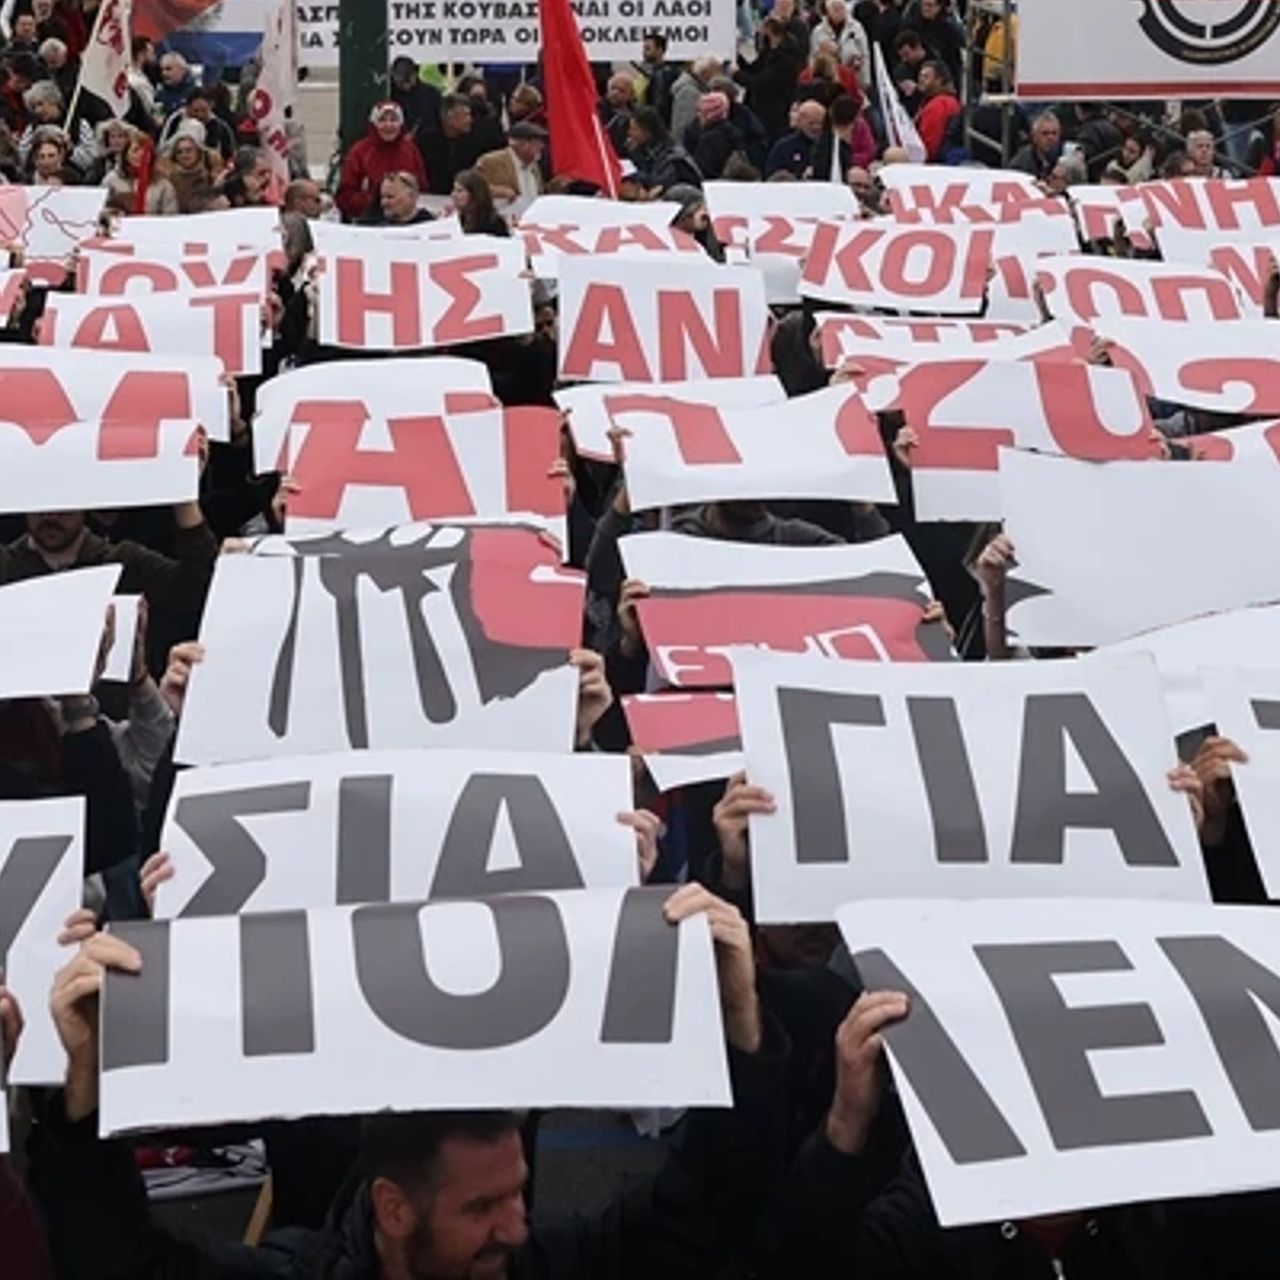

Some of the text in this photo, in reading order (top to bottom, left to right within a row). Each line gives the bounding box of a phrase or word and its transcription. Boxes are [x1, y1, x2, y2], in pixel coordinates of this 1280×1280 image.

[392, 3, 436, 19] ΤΗΣ
[444, 2, 539, 19] ΚΟΥΒΑΣ
[618, 1, 644, 16] ΟΙ
[653, 0, 712, 16] ΛΑΟΙ
[451, 28, 506, 45] ΤΩΡΑ
[776, 686, 1181, 868] ΓΙΑ
